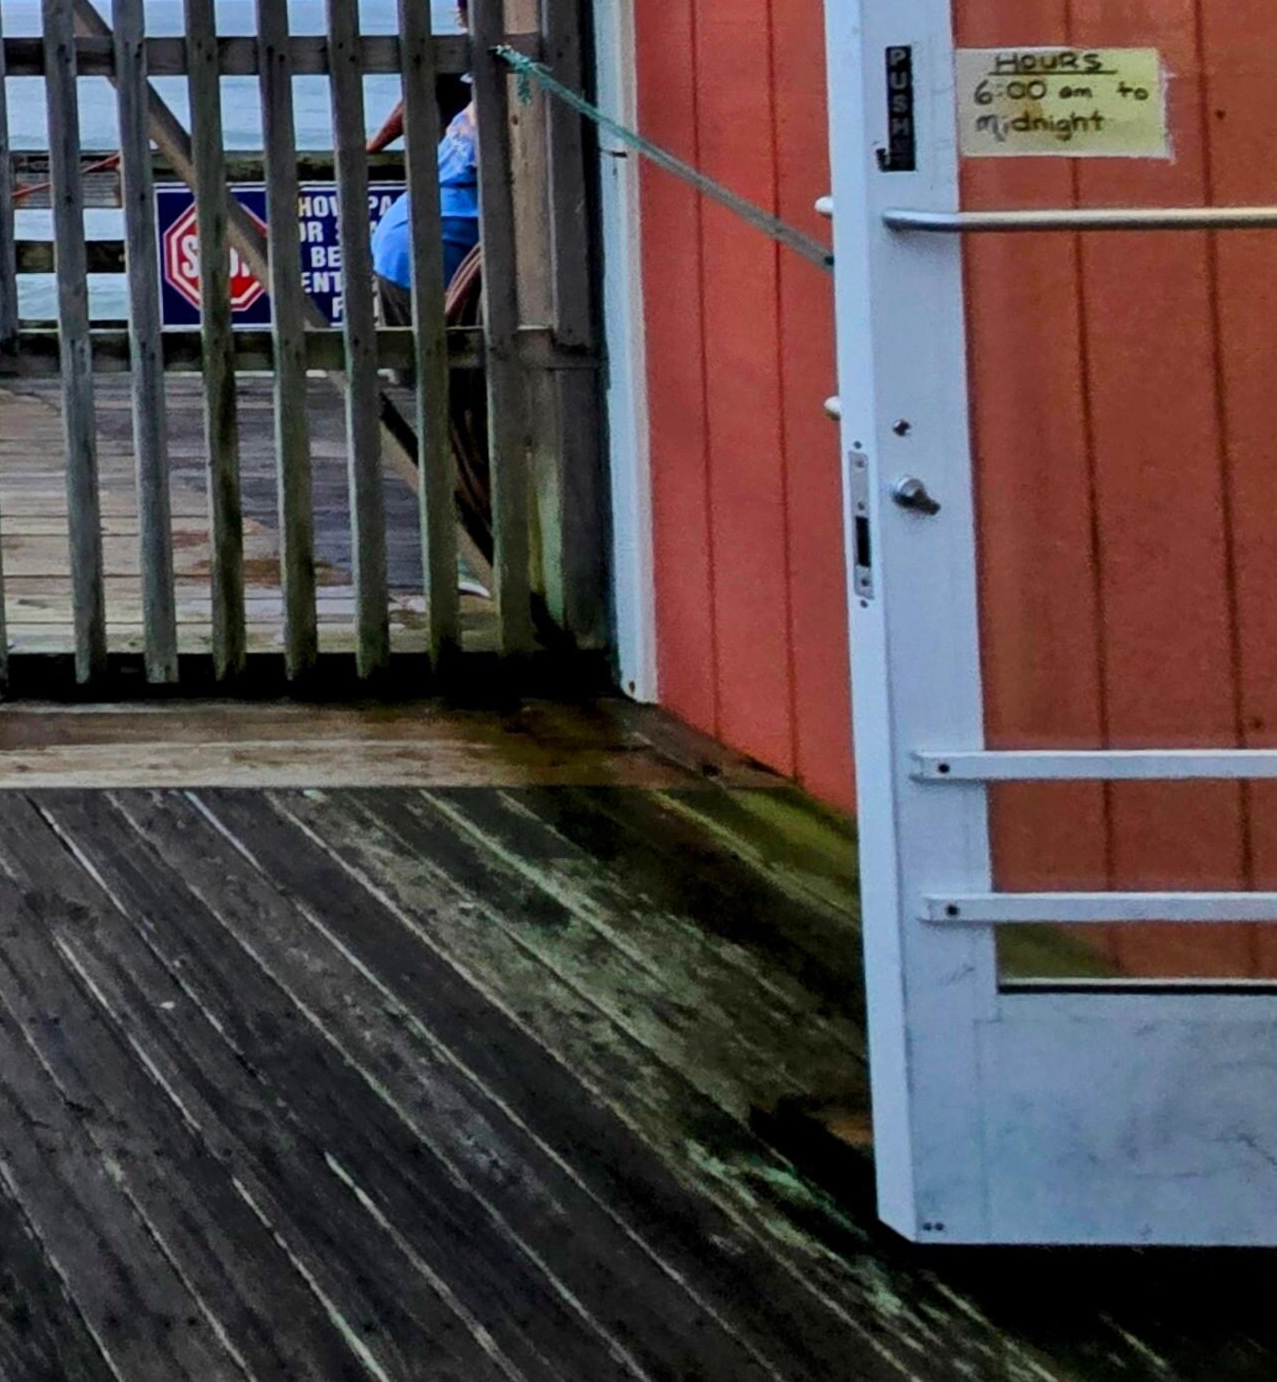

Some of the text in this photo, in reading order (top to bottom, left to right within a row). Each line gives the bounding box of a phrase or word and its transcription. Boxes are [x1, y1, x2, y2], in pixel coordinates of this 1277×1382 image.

[993, 50, 1104, 73] HOURS
[973, 79, 1048, 106] 6:00
[1117, 80, 1150, 101] to
